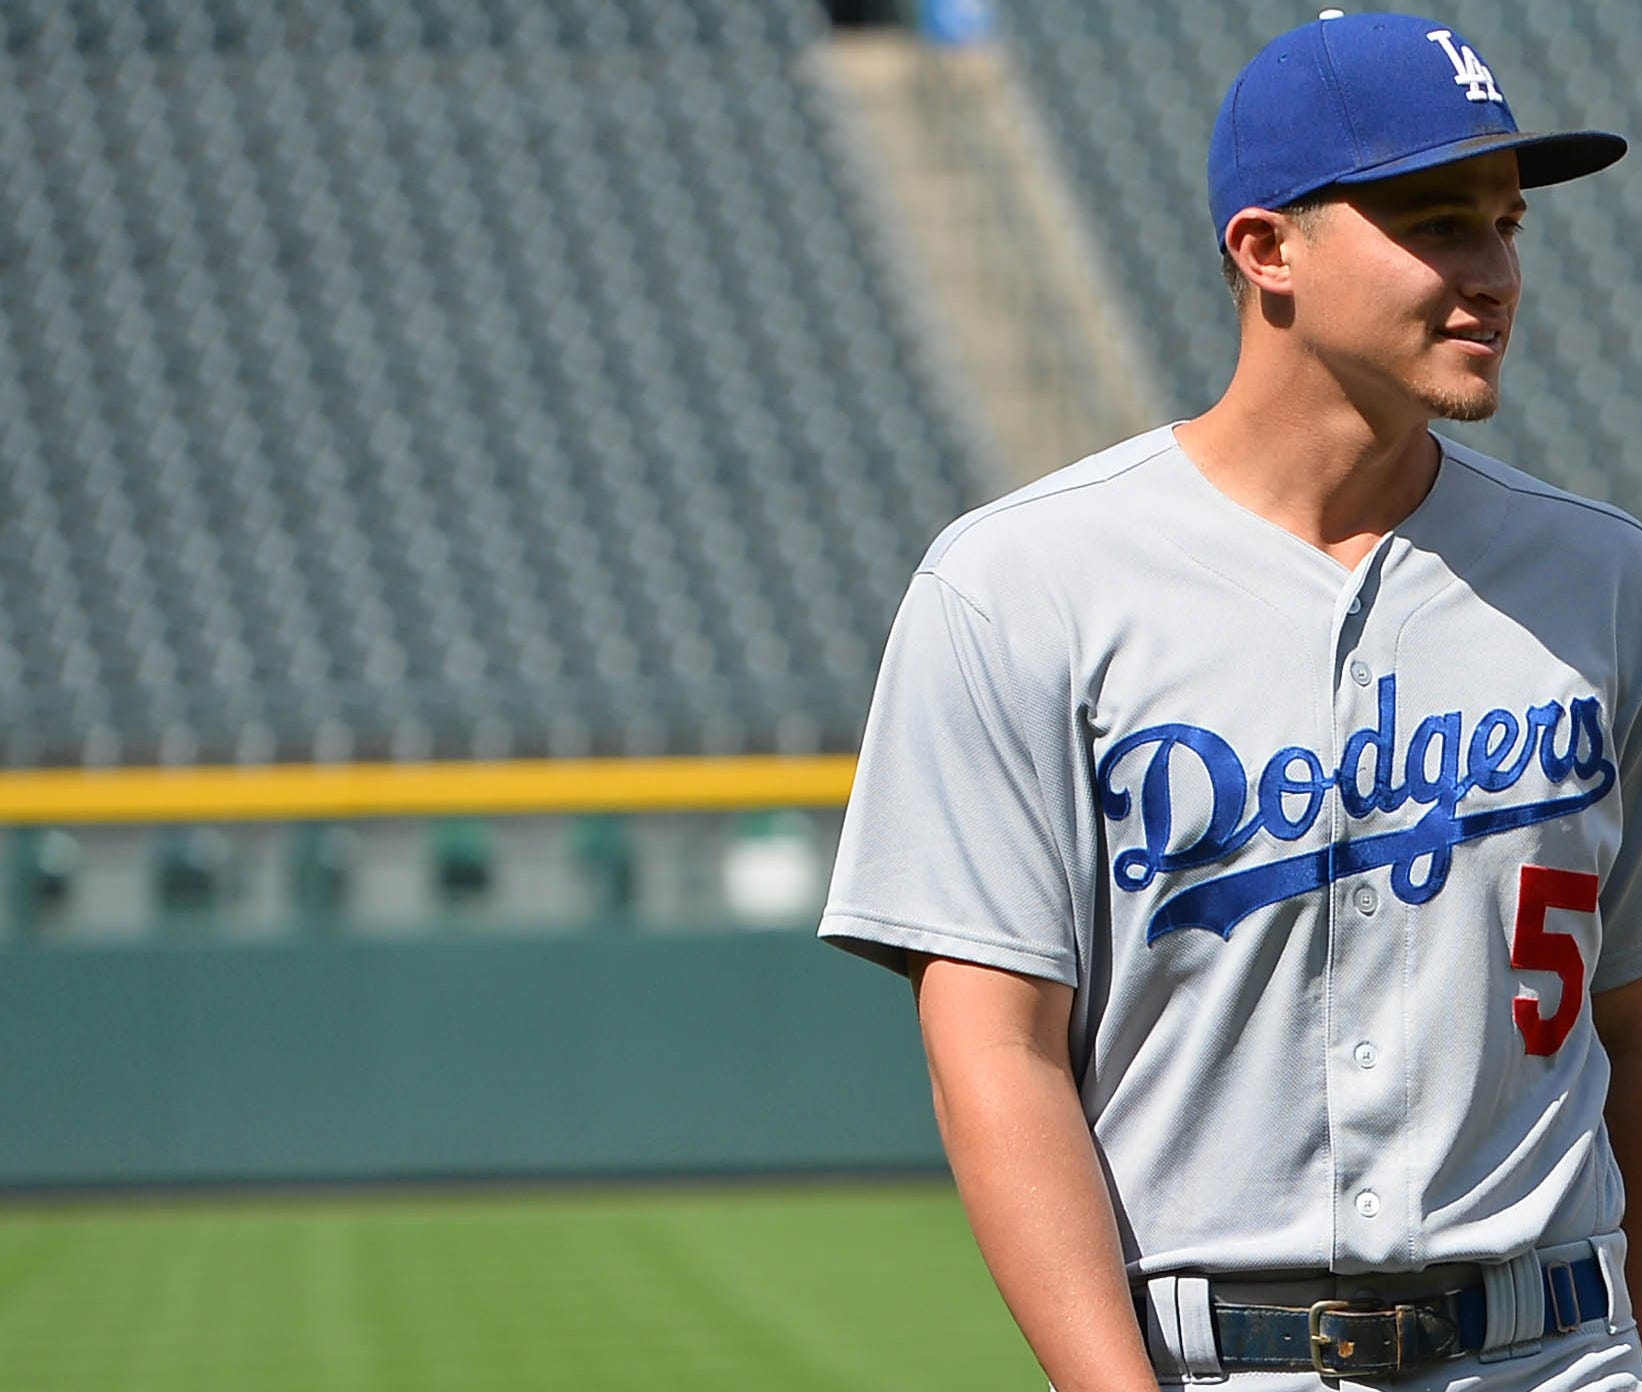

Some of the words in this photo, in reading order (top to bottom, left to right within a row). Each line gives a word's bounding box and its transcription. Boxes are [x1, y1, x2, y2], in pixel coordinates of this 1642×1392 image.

[1426, 29, 1503, 102] LA
[1097, 674, 1613, 906] Dodgers
[1511, 864, 1599, 1057] 5
